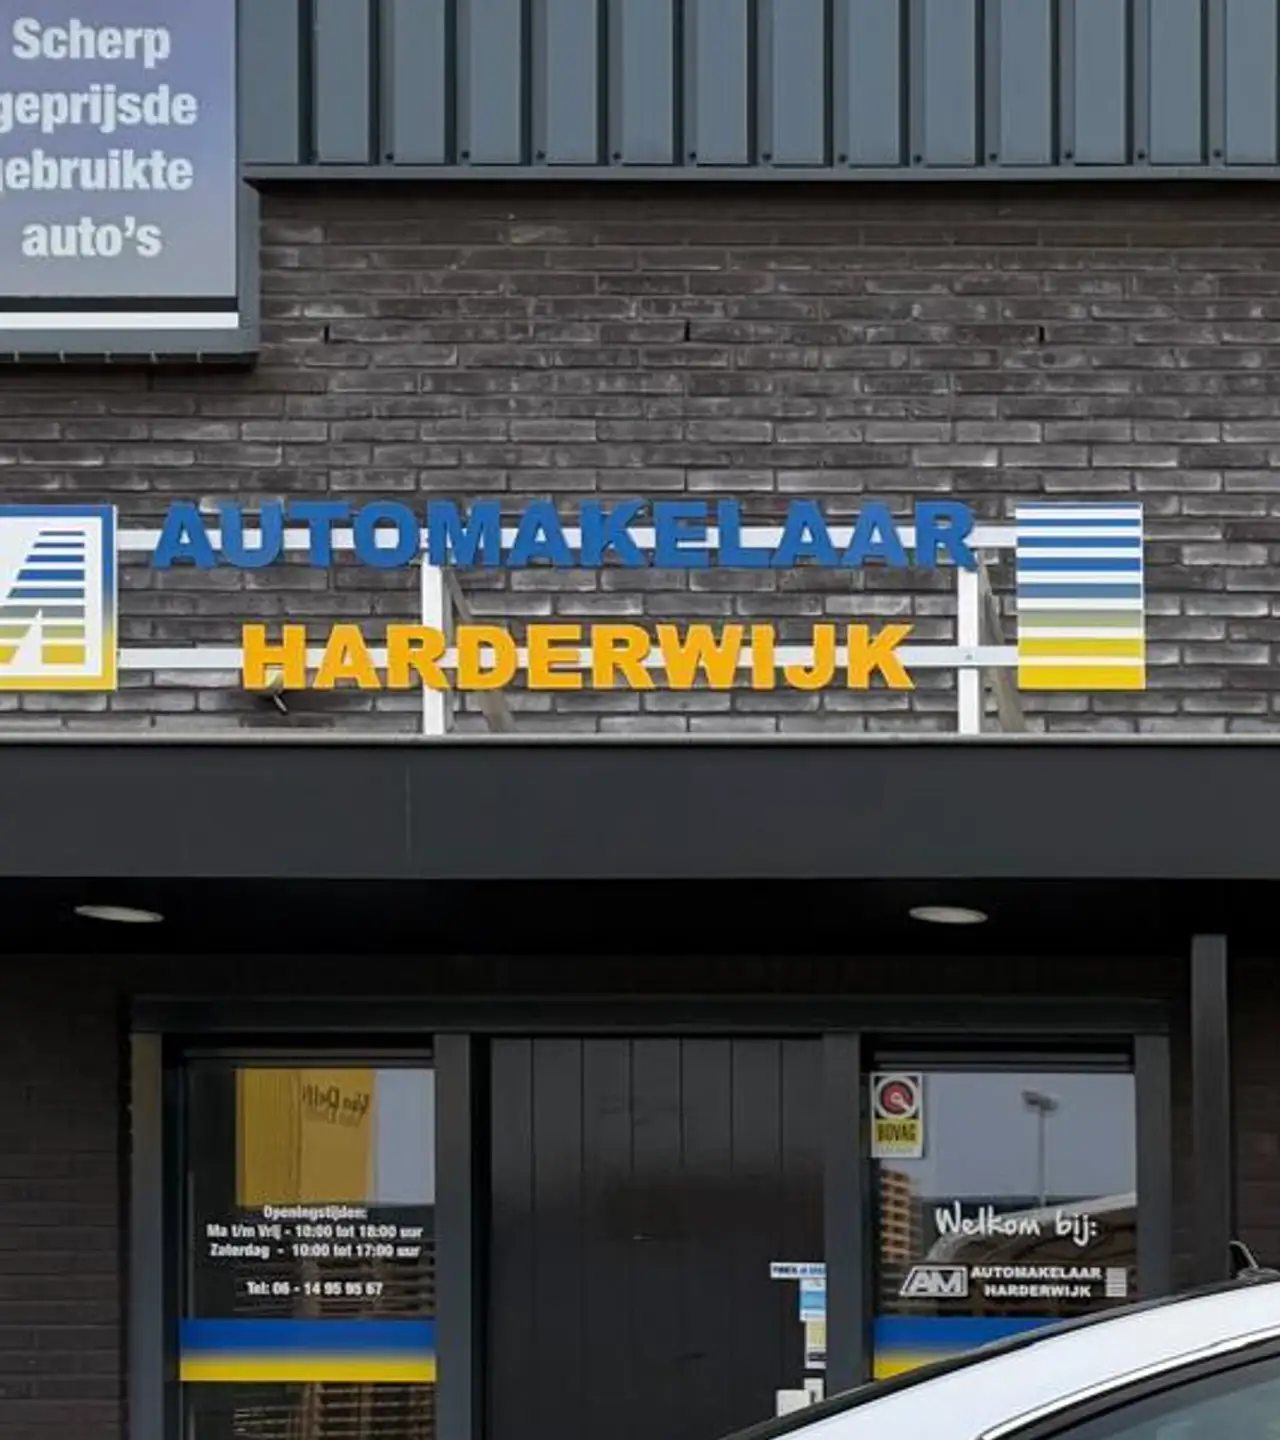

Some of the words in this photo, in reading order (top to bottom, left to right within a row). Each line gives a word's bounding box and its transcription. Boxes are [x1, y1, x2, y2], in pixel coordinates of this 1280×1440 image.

[12, 17, 172, 68] Scherp
[0, 149, 195, 192] ebruikte
[21, 215, 164, 258] auto's
[151, 499, 980, 572] AUTOMAKELAAR
[241, 623, 916, 692] HARDERWIJK
[263, 1205, 367, 1221] Openingstijden:
[935, 1200, 1041, 1237] Welkom
[1055, 1209, 1097, 1247] bij:
[207, 1224, 228, 1238] Ma
[336, 1224, 355, 1238] tot
[400, 1227, 423, 1238] uur
[210, 1244, 270, 1259] Zaterdag
[333, 1244, 352, 1257] tot
[396, 1247, 421, 1257] uur
[970, 1267, 1102, 1279] AUTOMAKELAAR
[247, 1282, 270, 1295] Tel:
[304, 1282, 320, 1295] 14
[984, 1285, 1092, 1298] HARDERWIJK
